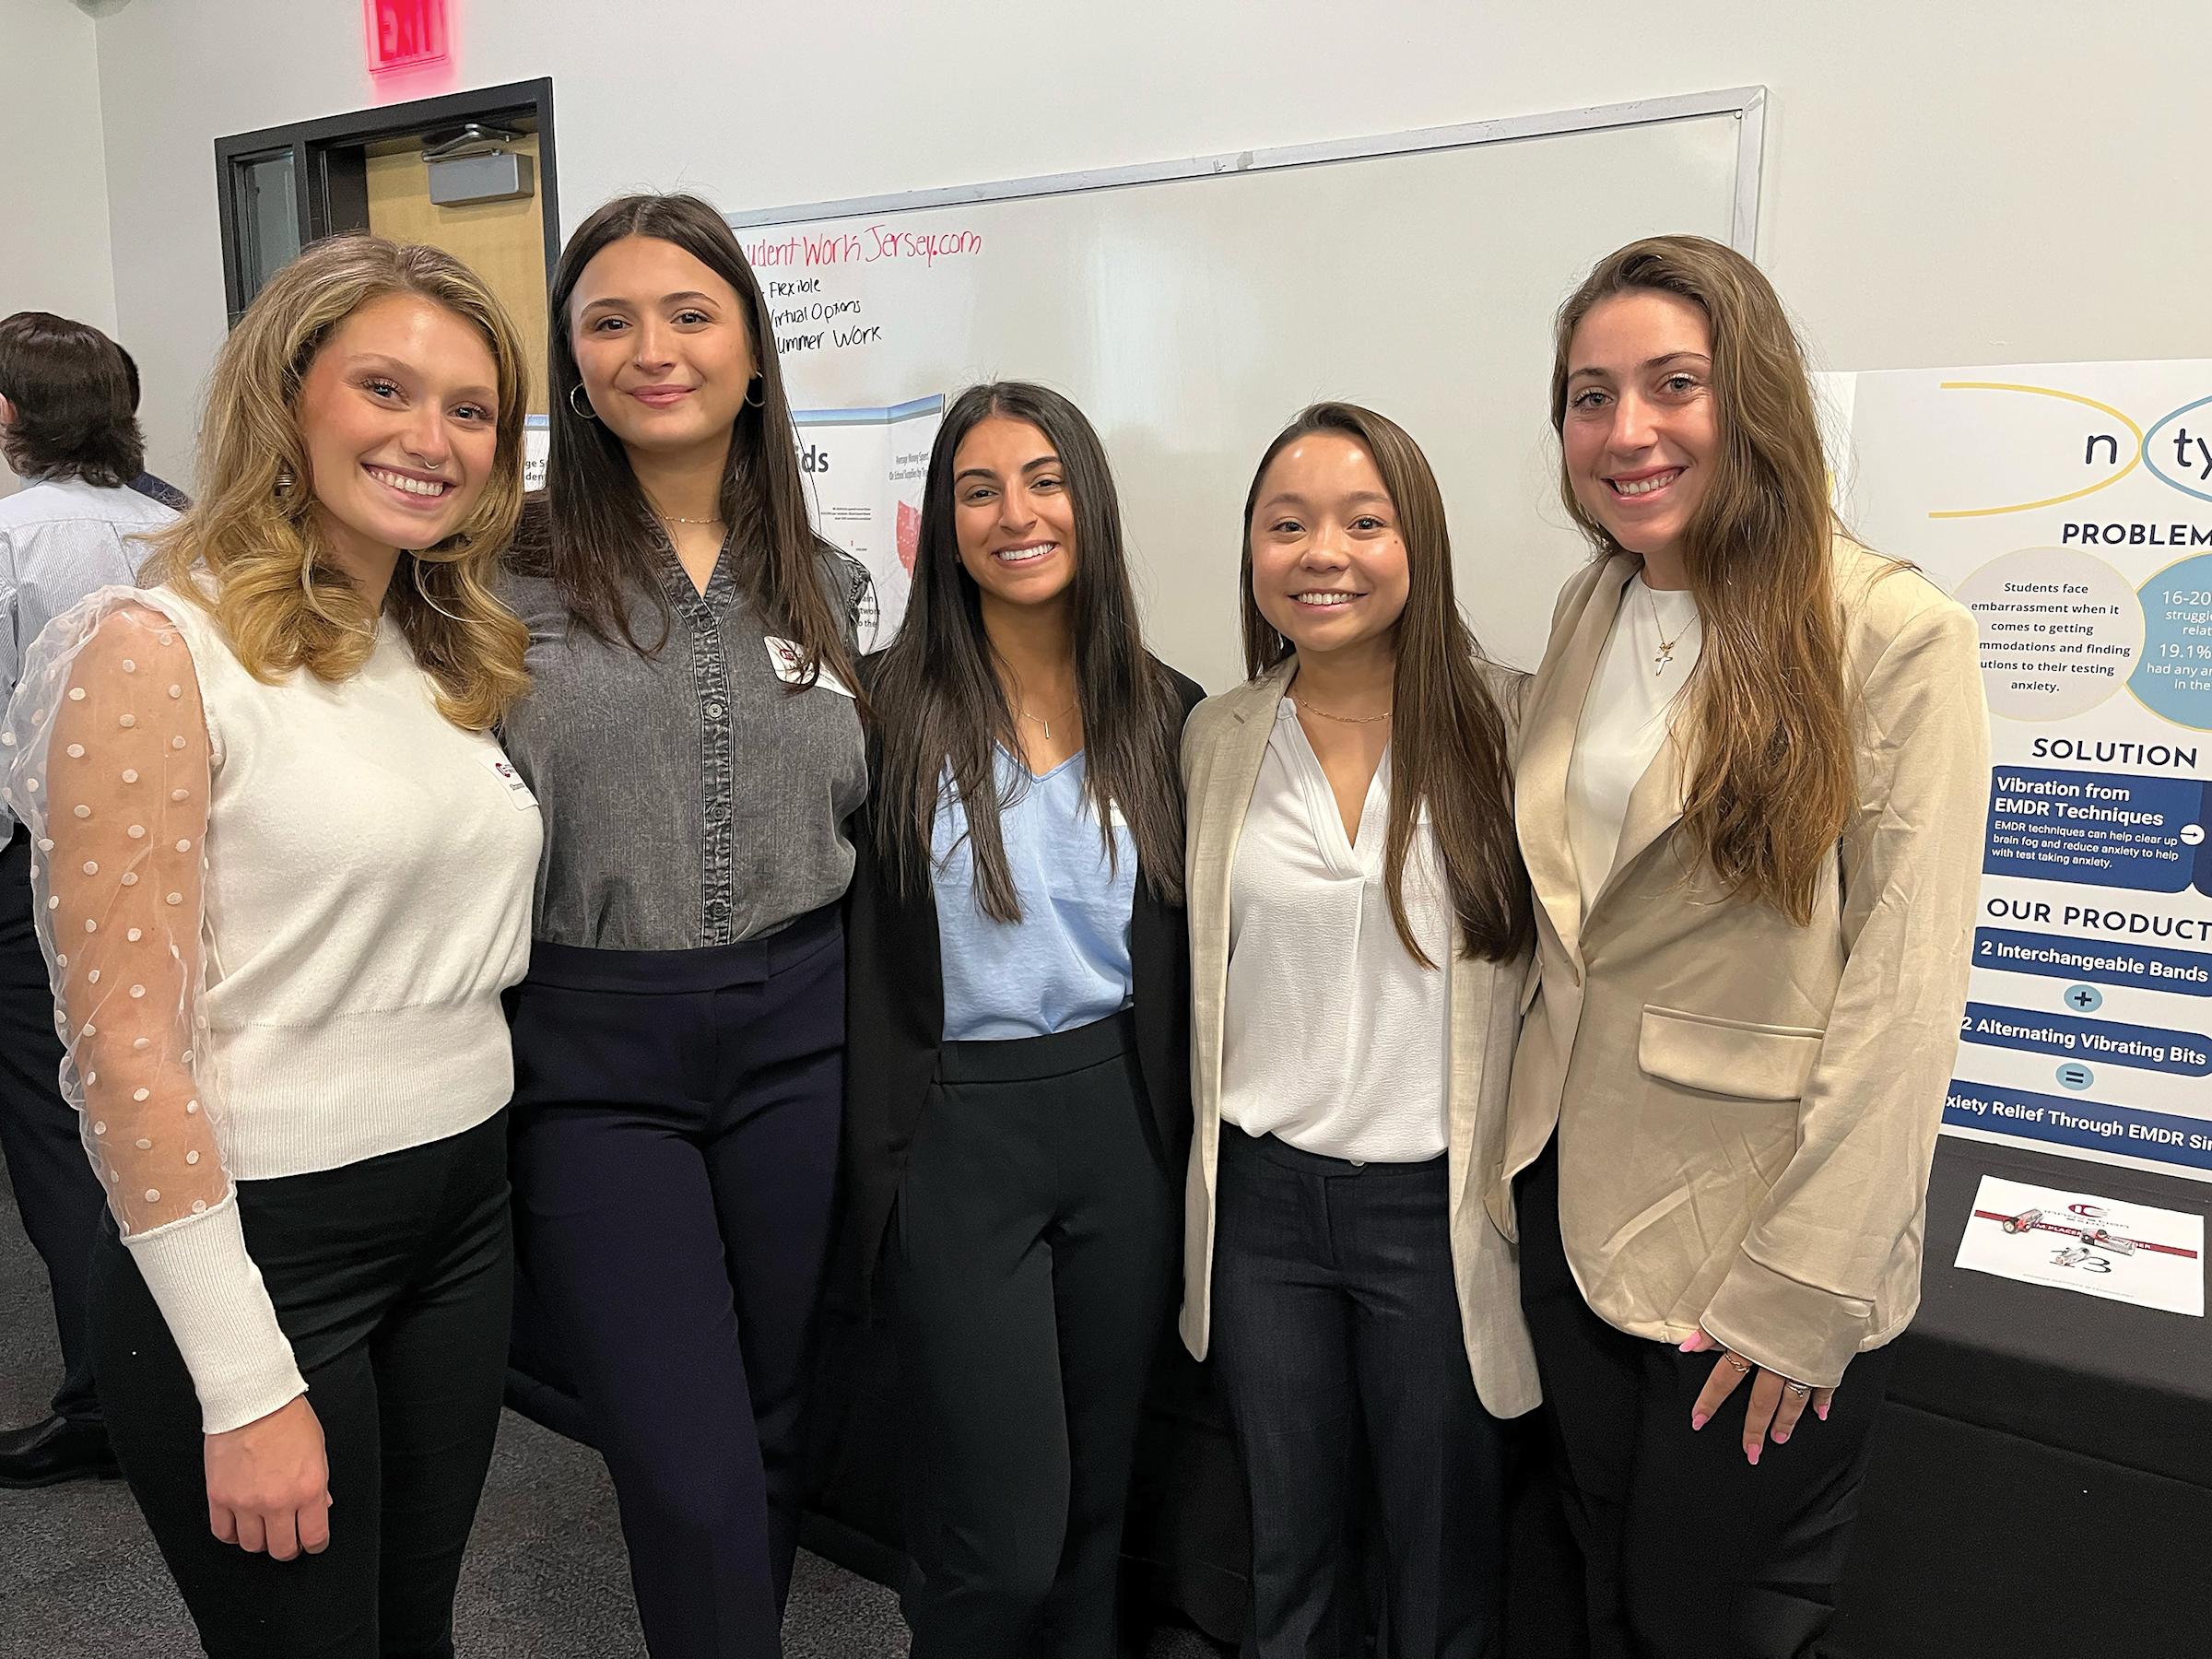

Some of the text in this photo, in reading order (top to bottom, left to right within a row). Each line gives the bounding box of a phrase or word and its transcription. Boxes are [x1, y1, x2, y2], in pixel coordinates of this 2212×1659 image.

[376, 0, 431, 61] EXIT
[769, 277, 821, 298] Flexible
[812, 300, 861, 324] Options
[833, 324, 882, 348] Work
[2062, 524, 2212, 546] PROBLEM
[2004, 582, 2088, 594] Students face
[2162, 590, 2212, 606] 16-20
[1971, 602, 2120, 615] embarrassment when it
[1991, 622, 2094, 636] comes to getting
[2059, 641, 2083, 653] and
[2086, 643, 2131, 657] finding
[2159, 643, 2212, 660] 19.1%
[2022, 661, 2033, 671] to
[2038, 662, 2067, 672] their
[2071, 664, 2115, 677] testing
[2147, 662, 2171, 675] had
[2174, 665, 2198, 678] any
[2011, 680, 2060, 692] anxiety.
[2174, 678, 2211, 690] in the
[2031, 737, 2197, 769] SOLUTION
[1996, 776, 2131, 802] Vibration from
[1994, 797, 2164, 827] EMDR Techniques
[1994, 820, 2178, 847] EMDR techniques can help clear up
[1992, 848, 2112, 869] with test taking anxiety.
[1993, 834, 2179, 862] brain fog and reduce anxiety to help
[1987, 898, 2212, 942] OUR PRODUCT
[1981, 940, 2209, 982] 2 Interchangeable Bands
[1961, 1016, 2206, 1065] 2 Alternating Vibrating Bits
[1992, 1100, 2044, 1123] Relief
[2048, 1109, 2124, 1136] Through
[2128, 1124, 2185, 1147] EMDR
